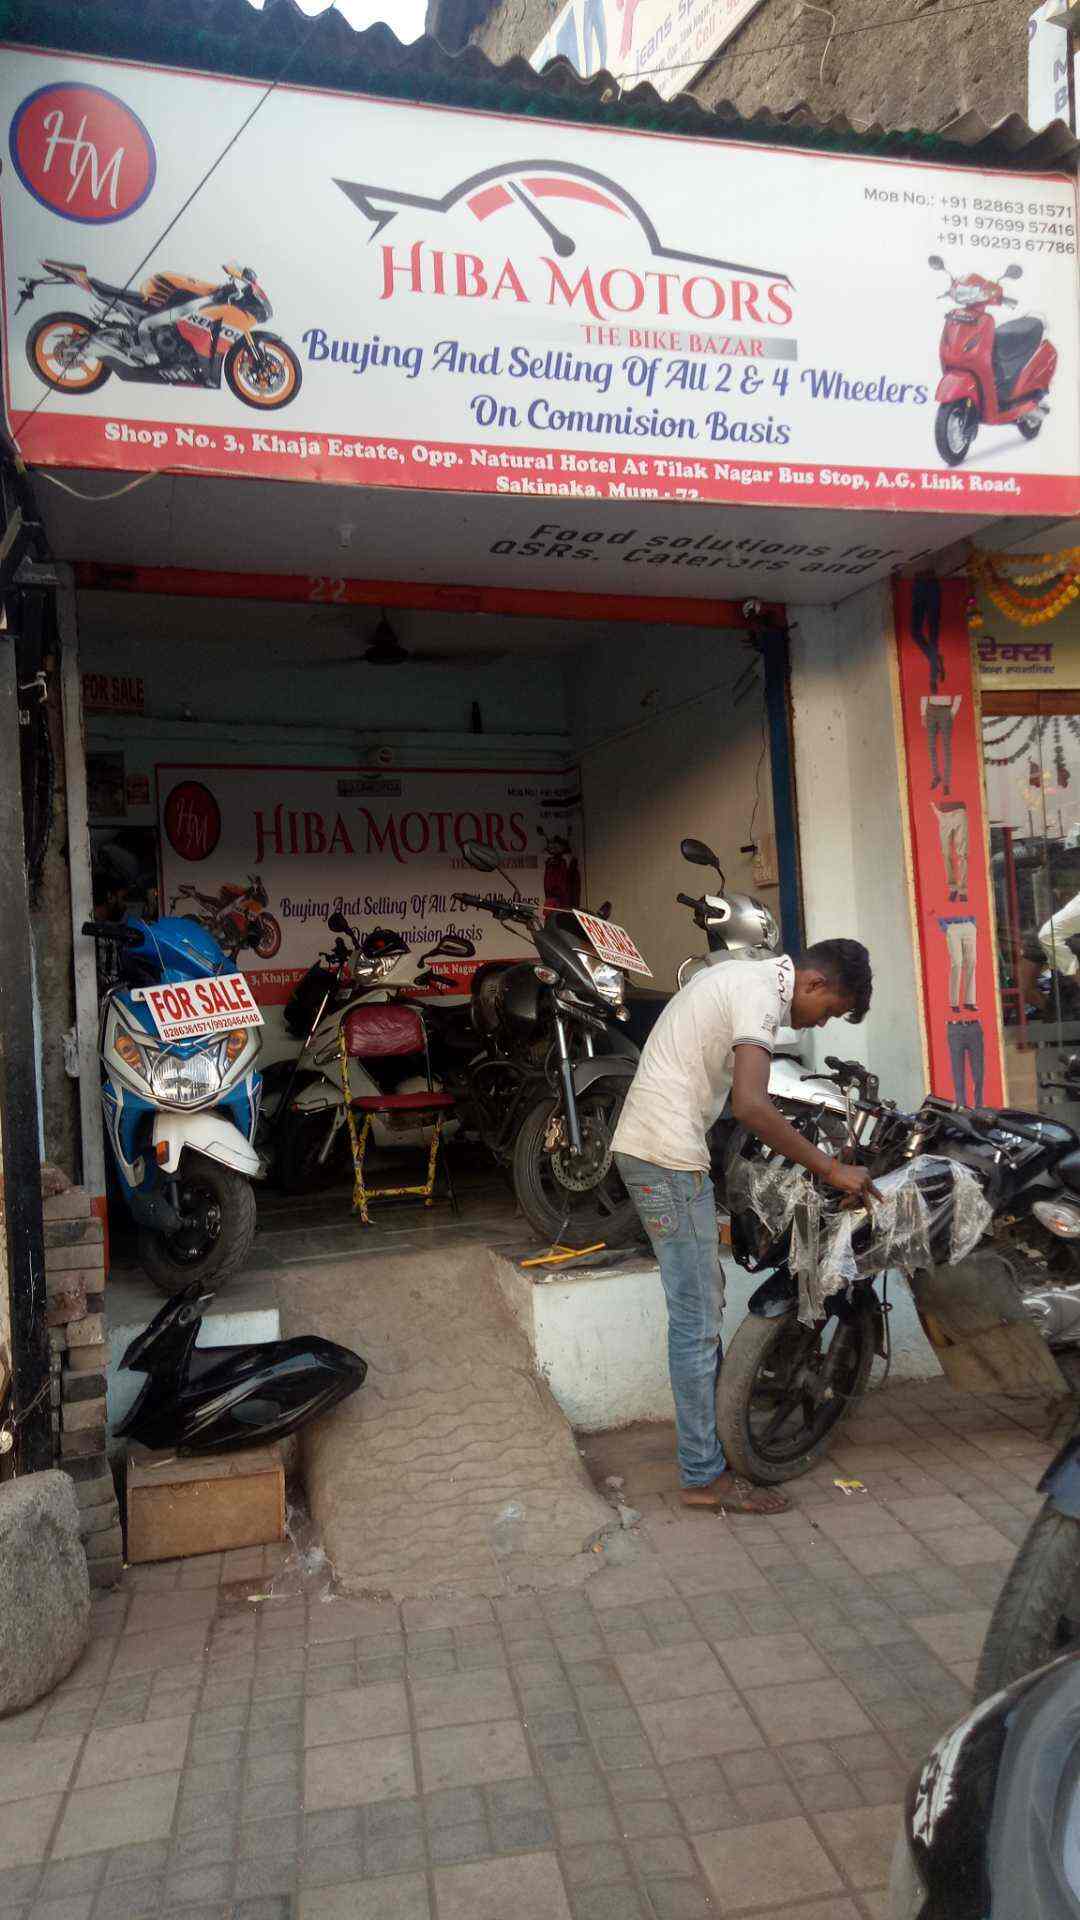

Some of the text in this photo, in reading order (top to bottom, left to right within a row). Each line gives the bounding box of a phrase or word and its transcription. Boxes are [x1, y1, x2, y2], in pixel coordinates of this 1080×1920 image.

[941, 196, 968, 210] +91
[972, 198, 1024, 215] 82863
[1027, 202, 1073, 219] 61571
[942, 214, 1075, 237] +91 97699 57416
[937, 231, 1076, 255] +91 90293 67786
[379, 240, 793, 326] HIBA MOTORS
[580, 324, 766, 358] THE BIKE BAZAR
[301, 328, 930, 405] Buying And Selling Of All 2 & 4 Wheelers
[470, 394, 793, 446] On Commision Basis
[104, 423, 1023, 495] Shop No. 3, Khaja Estate, Opp. Natural Hotel At Tilak Nagar Bus Stop, A.G. Link Road,
[529, 523, 638, 546] Food
[646, 532, 833, 560] solutions
[839, 542, 898, 561] for
[799, 561, 878, 576] and
[83, 674, 144, 705] FOR SALE
[252, 803, 529, 865] HIBA MOTORS
[280, 897, 330, 923] Buying
[364, 896, 407, 920] Selling
[410, 894, 427, 919] Of
[428, 894, 446, 914] All
[150, 978, 252, 1023] FOR SALE
